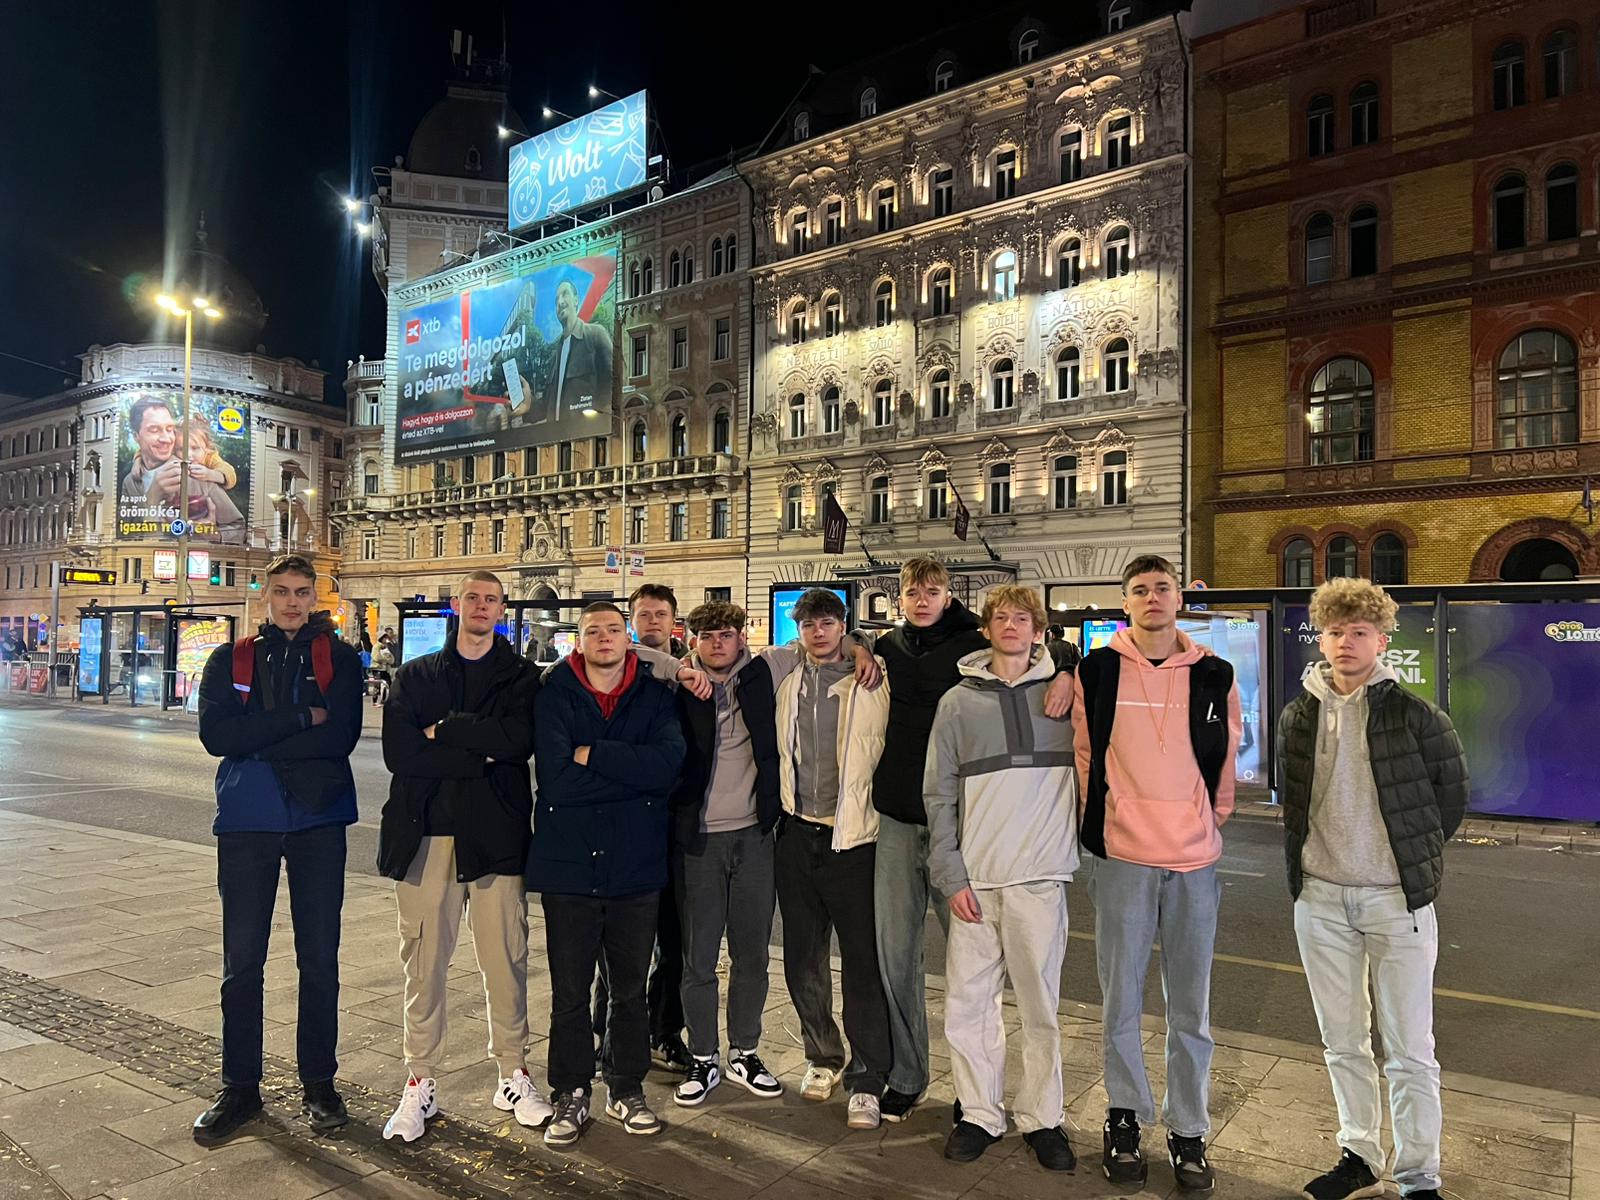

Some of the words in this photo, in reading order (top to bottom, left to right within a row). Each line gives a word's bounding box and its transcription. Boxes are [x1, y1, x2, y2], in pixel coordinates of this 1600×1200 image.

[548, 139, 605, 186] Wolt
[987, 314, 1017, 329] HOTEL
[1052, 292, 1128, 317] NATIONAL
[422, 316, 441, 336] xtb
[405, 354, 422, 373] Te
[424, 325, 526, 369] megdolgozol
[786, 348, 839, 368] NEMZETI
[403, 382, 413, 398] a
[414, 361, 493, 401] pénzedért
[130, 494, 147, 504] apró
[120, 505, 181, 518] örömökér
[120, 520, 157, 534] igazán
